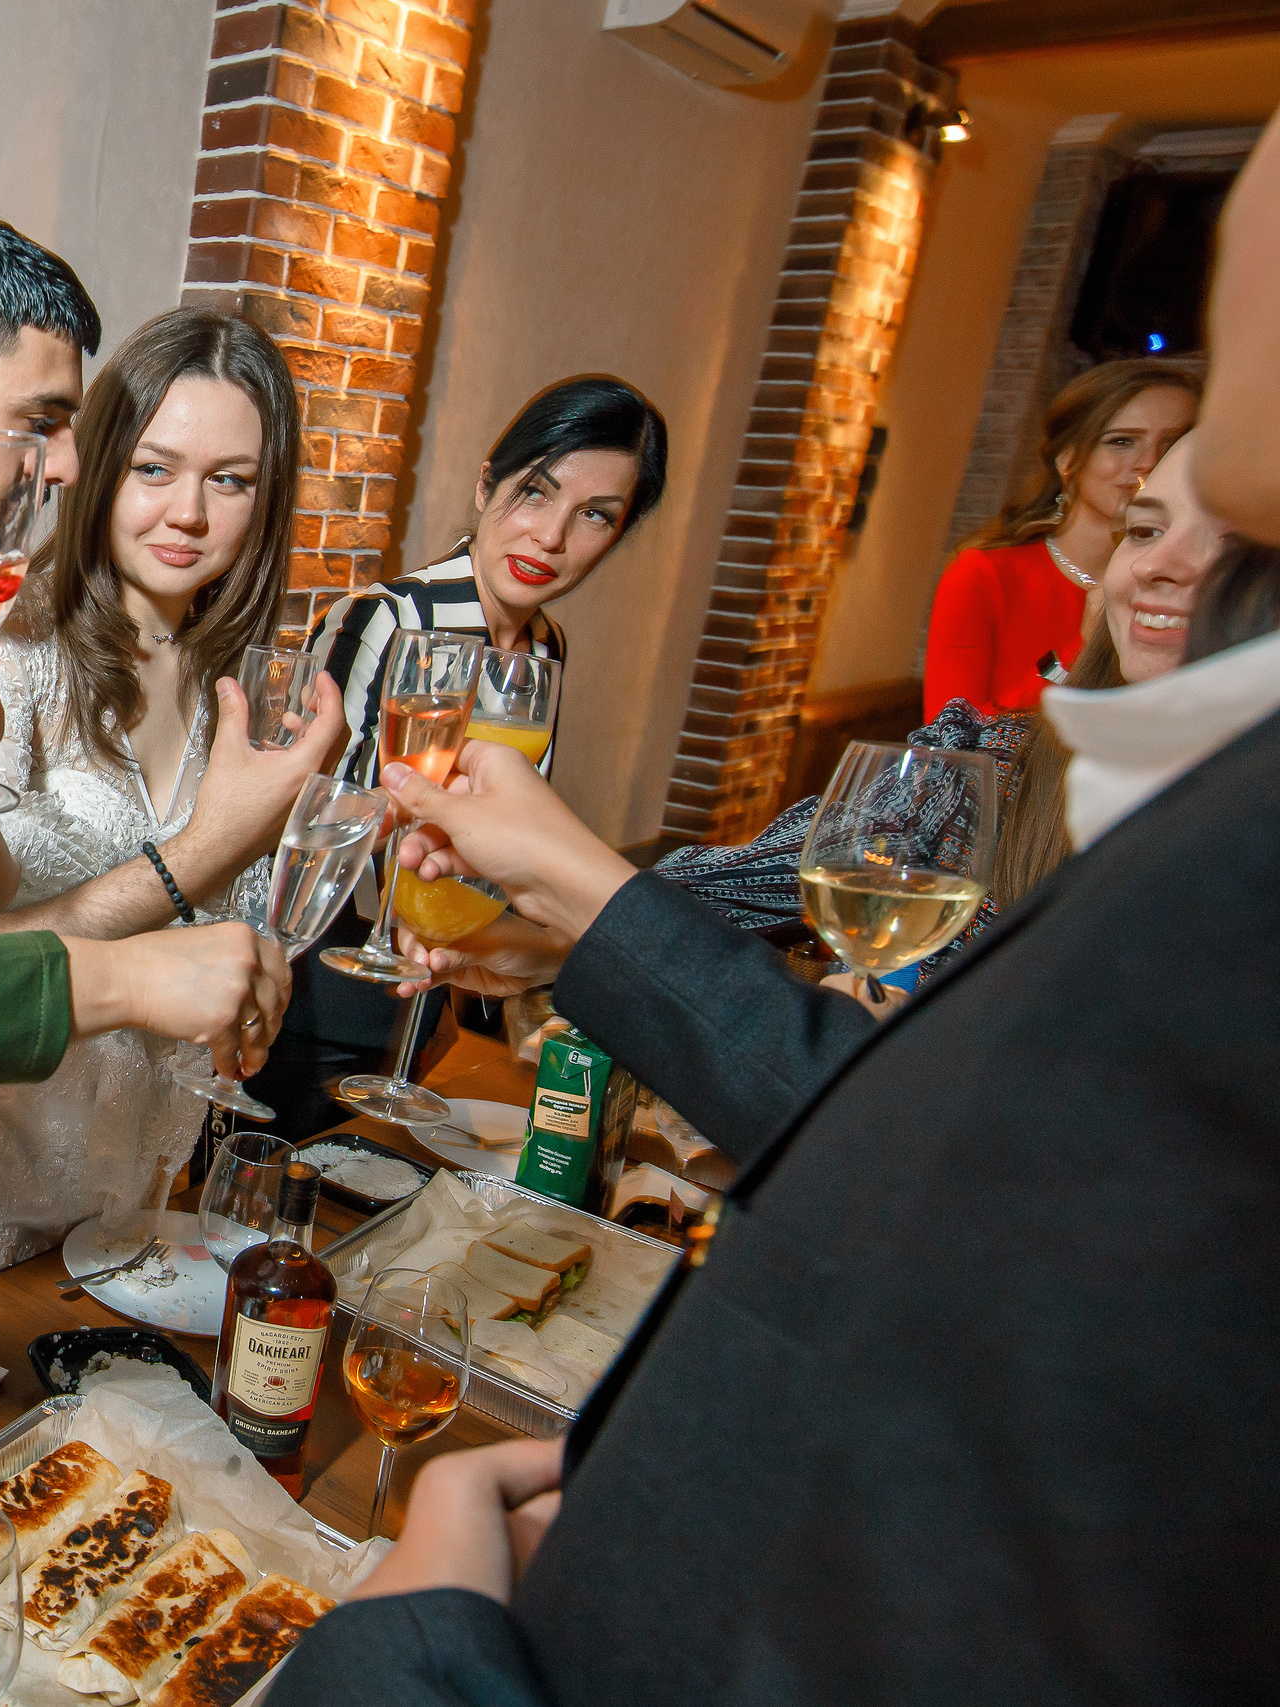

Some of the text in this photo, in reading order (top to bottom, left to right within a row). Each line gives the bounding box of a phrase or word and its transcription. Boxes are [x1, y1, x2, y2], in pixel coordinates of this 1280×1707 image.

[260, 1331, 288, 1339] BACARDI
[248, 1337, 311, 1359] OAKHEART
[256, 1361, 278, 1373] SPIRIT
[266, 1359, 291, 1367] PREMIUM
[249, 1395, 280, 1406] AMERICAN
[235, 1419, 299, 1436] ORIGINAL OAKHEART
